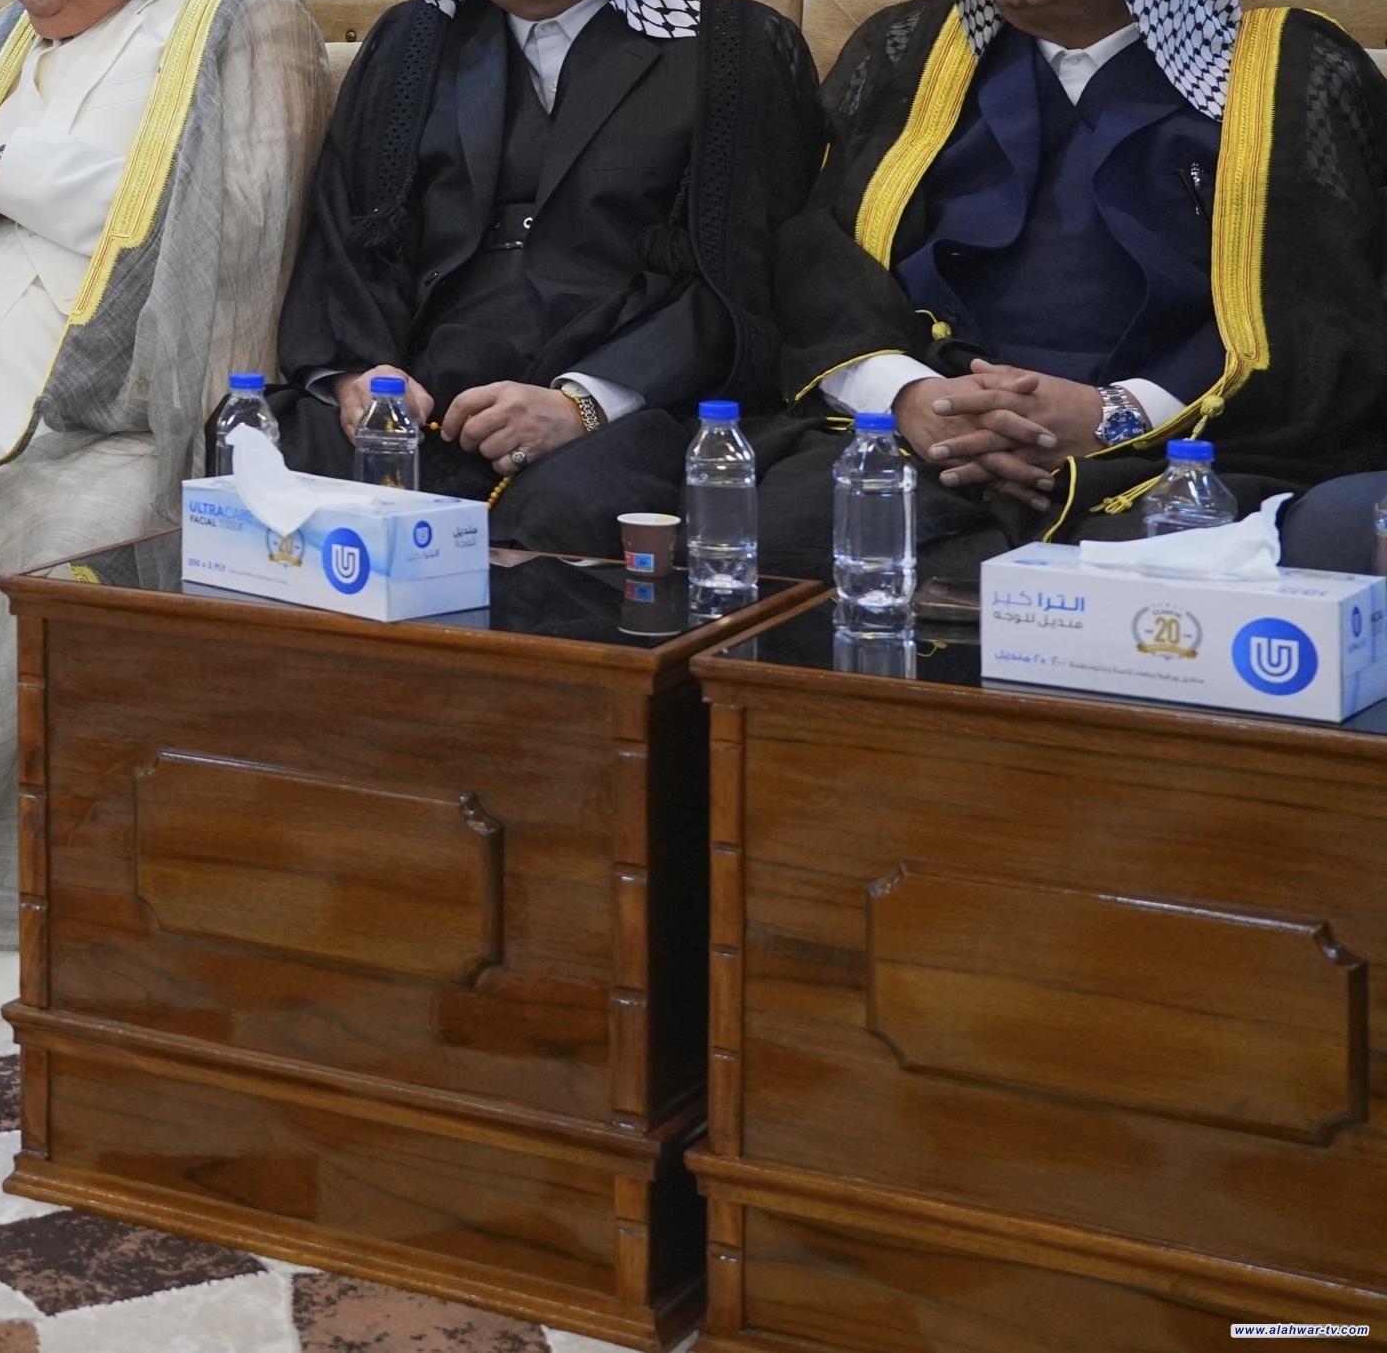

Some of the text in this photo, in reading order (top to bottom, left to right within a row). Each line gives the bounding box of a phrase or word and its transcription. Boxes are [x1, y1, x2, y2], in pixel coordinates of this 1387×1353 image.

[190, 514, 217, 527] FACIAL
[1038, 592, 1085, 613] الترا
[1037, 614, 1084, 629] منديل
[1154, 616, 1181, 645] 20
